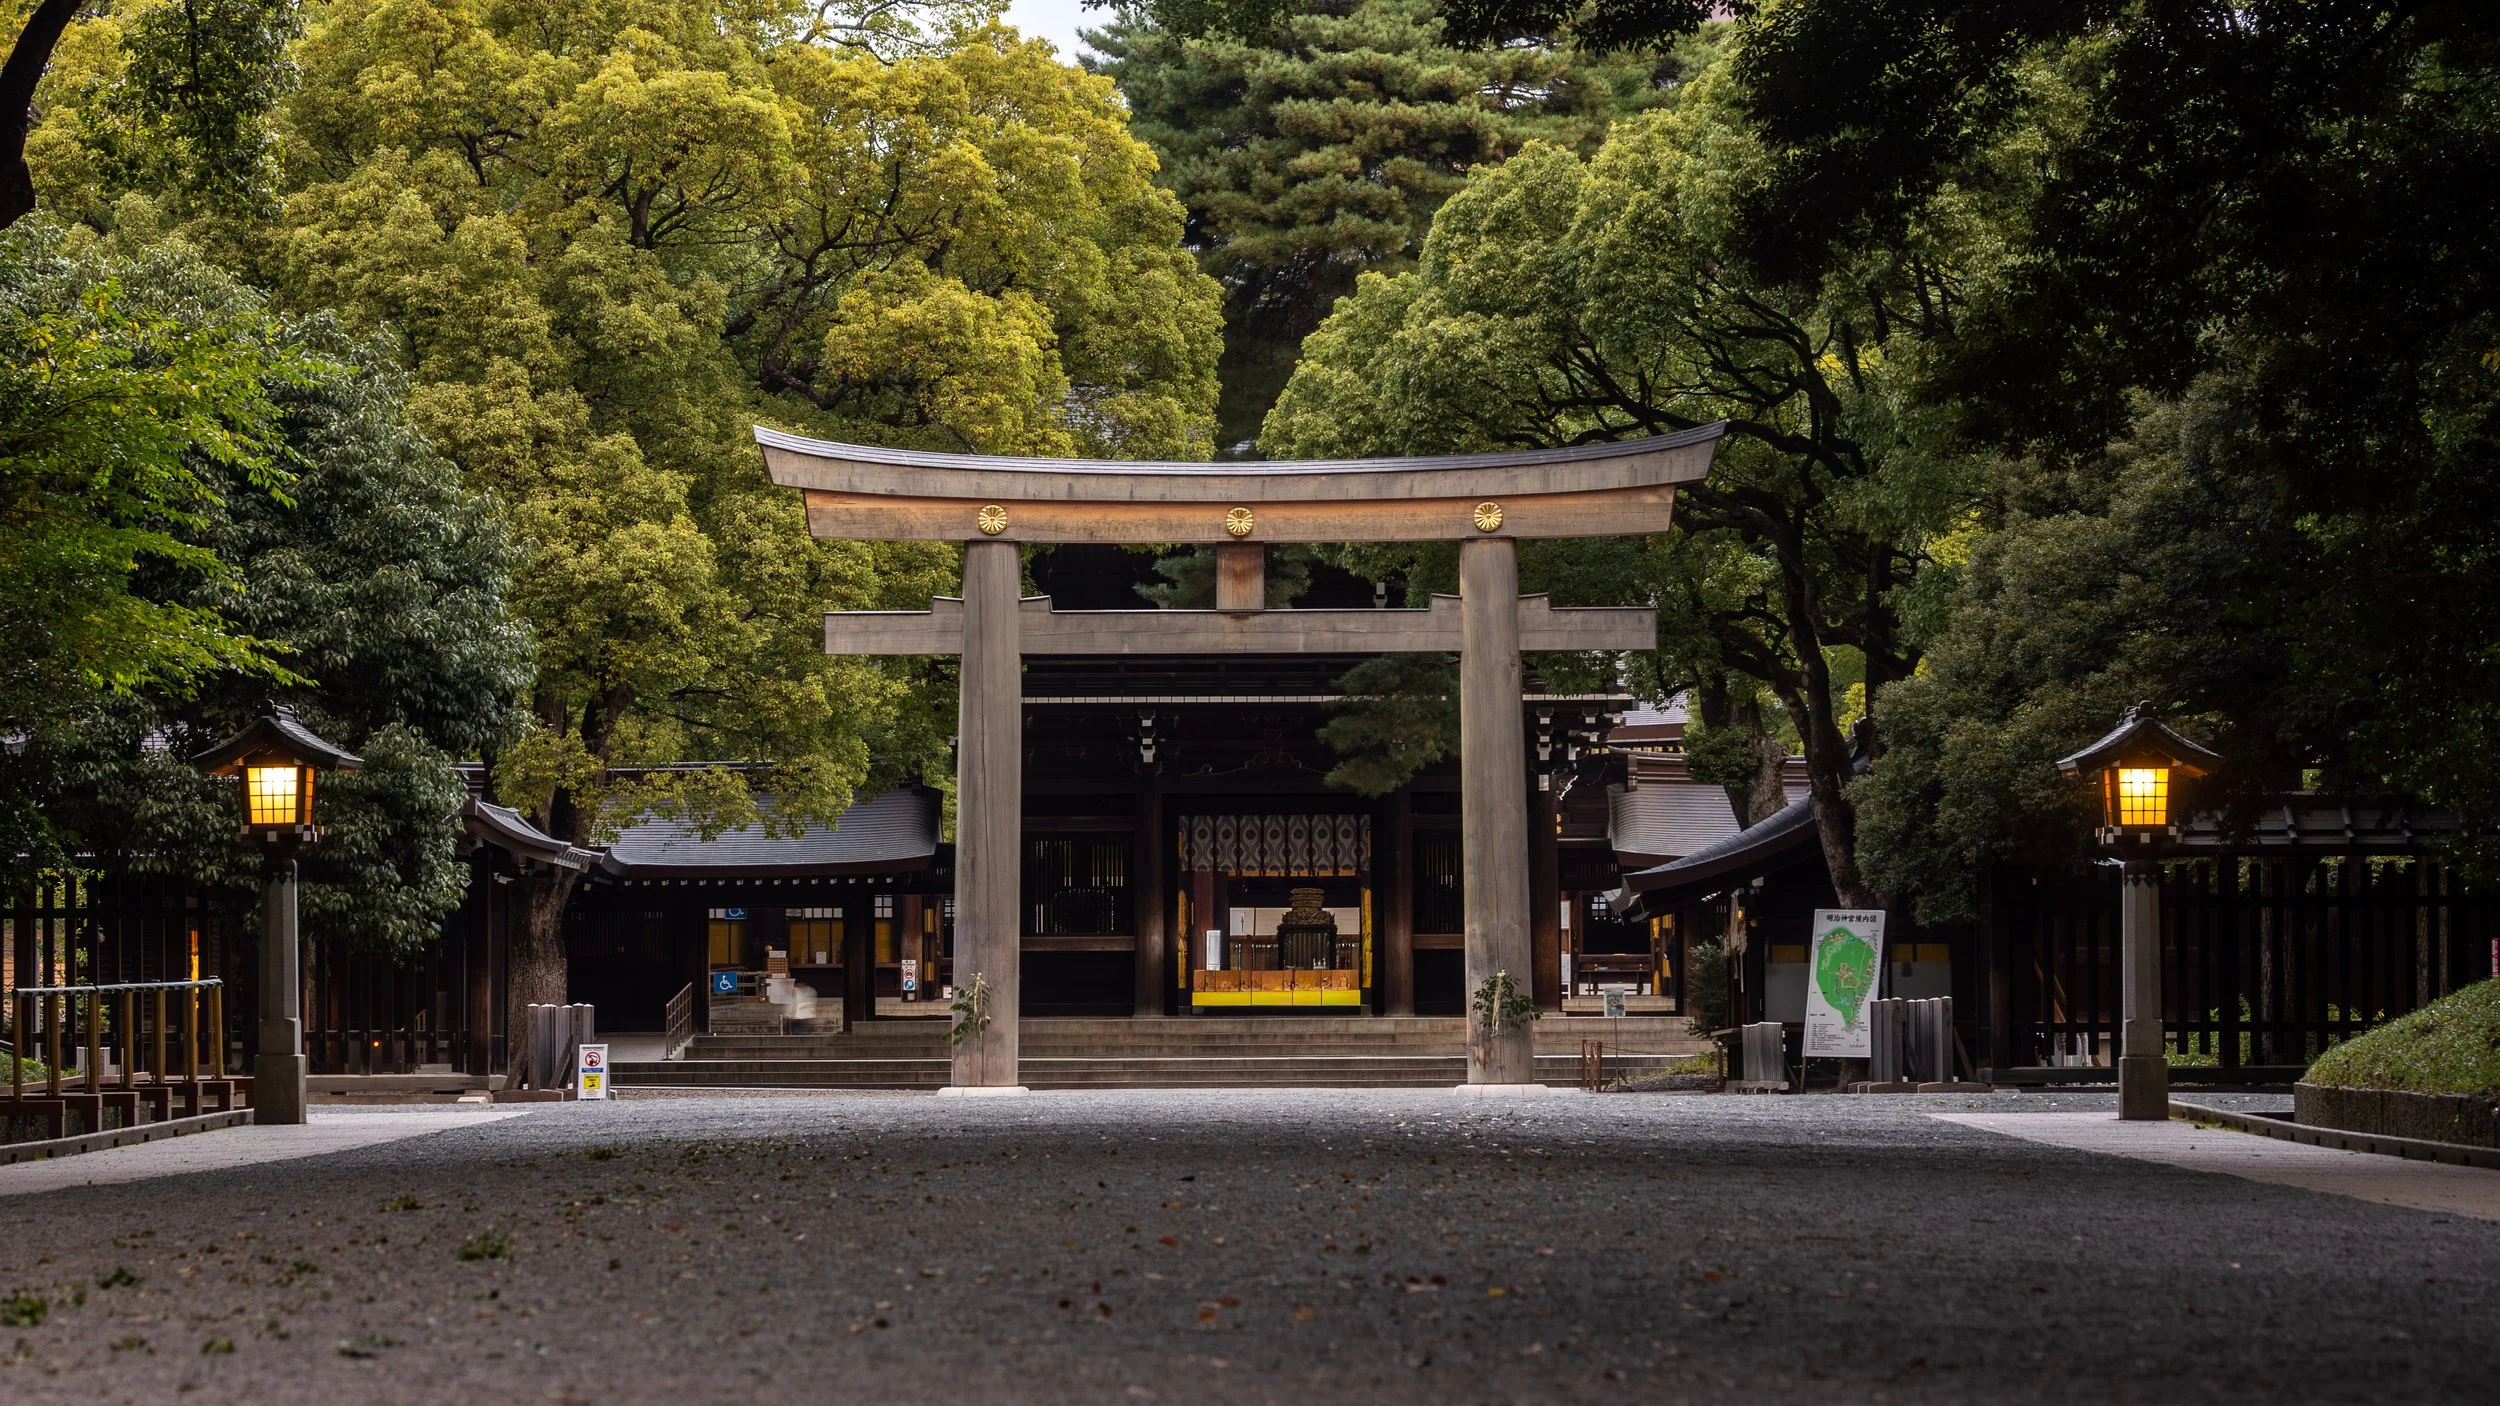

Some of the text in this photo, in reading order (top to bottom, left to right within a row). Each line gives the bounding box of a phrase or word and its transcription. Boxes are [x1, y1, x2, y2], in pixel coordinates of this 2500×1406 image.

[1826, 914, 1877, 923] 明治神宮境内図
